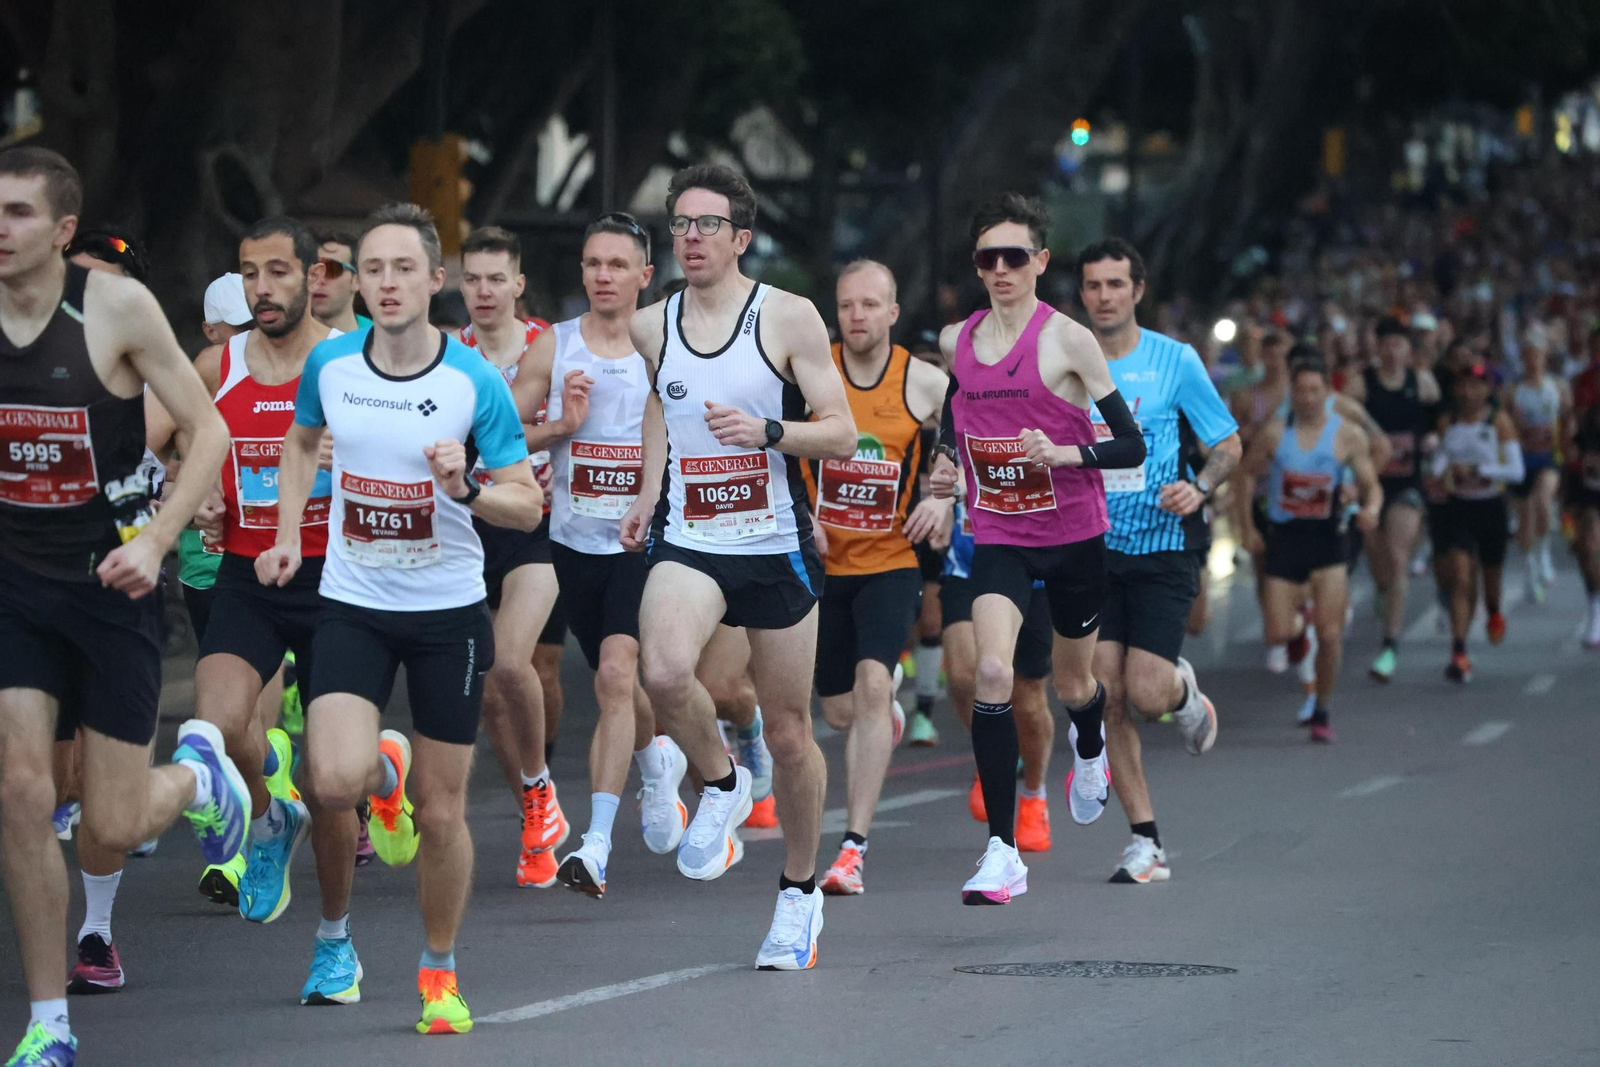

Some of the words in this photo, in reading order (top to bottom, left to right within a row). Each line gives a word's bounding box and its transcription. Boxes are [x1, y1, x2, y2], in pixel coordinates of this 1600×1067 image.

[744, 309, 757, 335] soar
[342, 392, 412, 411] Norconsult
[6, 411, 78, 429] GENERALI
[9, 442, 62, 463] 5995
[700, 456, 761, 472] GENERALI
[841, 462, 894, 476] GENERALI
[988, 465, 1024, 479] 5481
[587, 469, 636, 485] 14785
[361, 480, 426, 499] GENERALI
[698, 484, 751, 503] 10629
[838, 483, 877, 499] 4727
[356, 508, 412, 529] 14761
